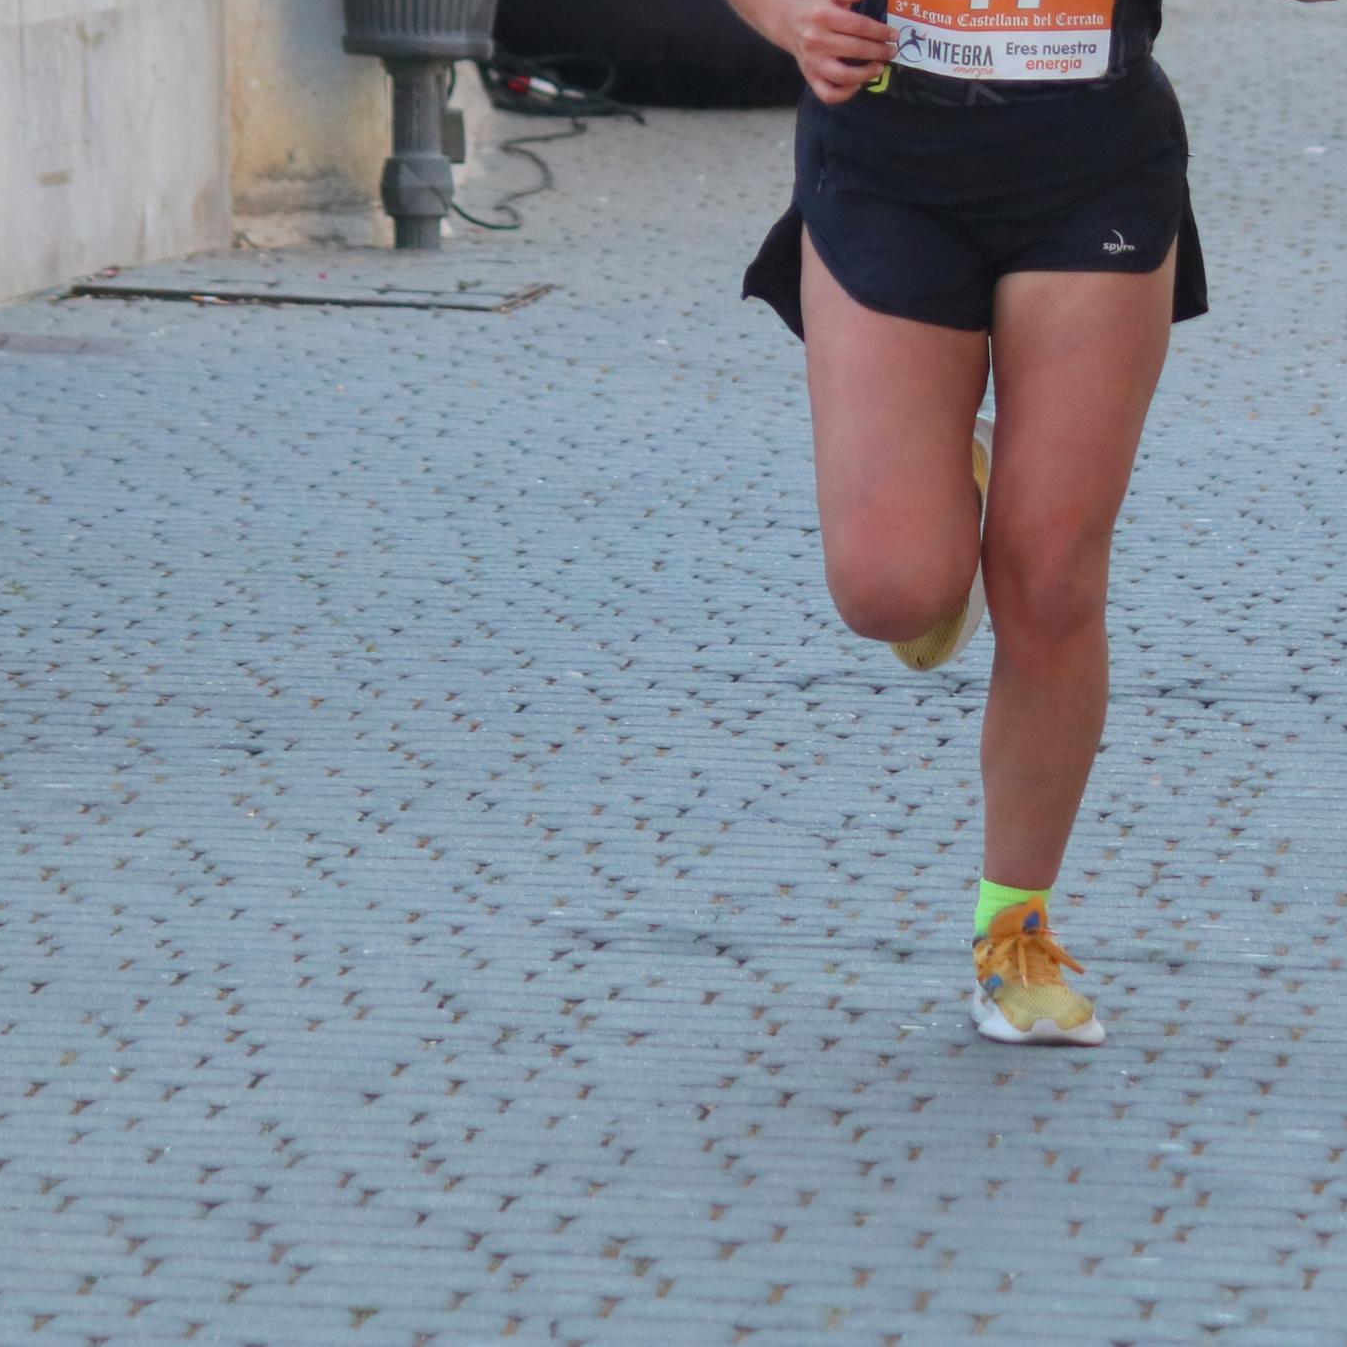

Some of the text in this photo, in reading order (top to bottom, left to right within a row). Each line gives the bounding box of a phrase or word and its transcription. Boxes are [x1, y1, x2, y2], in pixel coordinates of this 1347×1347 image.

[912, 2, 953, 26] Legua
[957, 12, 1029, 28] Castellana
[1033, 13, 1052, 27] del
[1056, 12, 1104, 27] Cerrato
[927, 37, 994, 67] INTEGRA
[1006, 40, 1097, 56] Eres nuestra
[1026, 55, 1082, 74] energía
